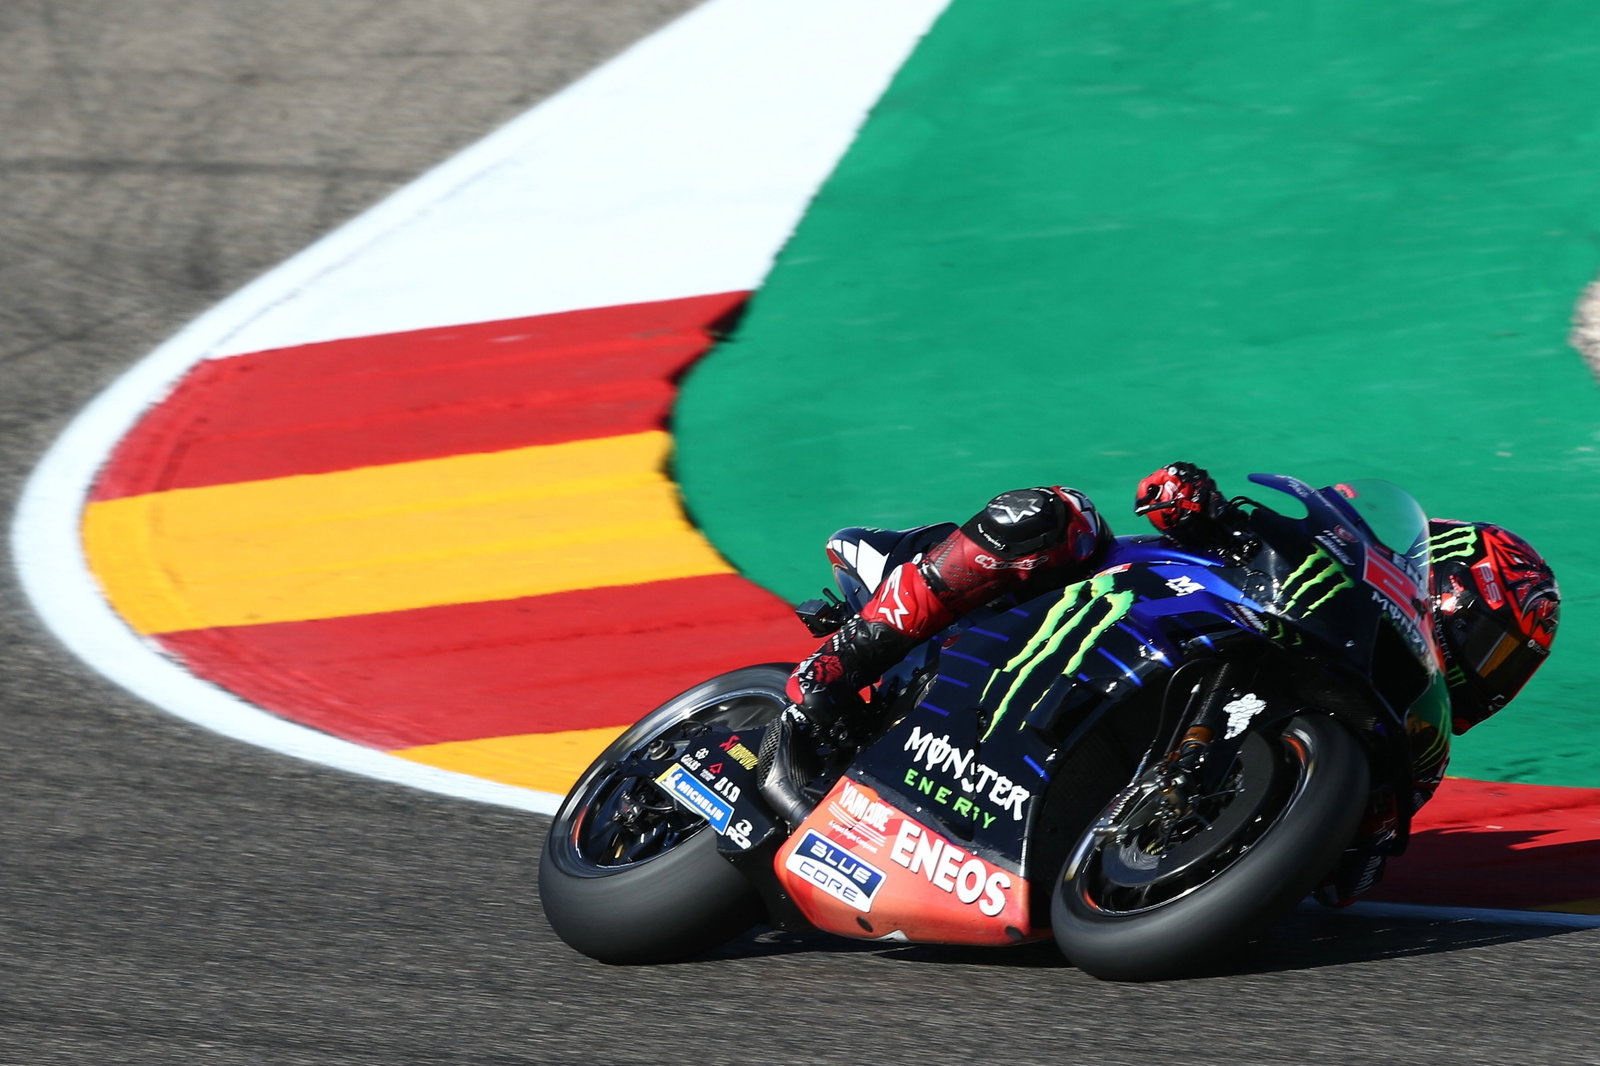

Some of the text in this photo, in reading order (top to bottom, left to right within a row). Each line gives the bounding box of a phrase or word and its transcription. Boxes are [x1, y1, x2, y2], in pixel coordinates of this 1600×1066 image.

[677, 781, 725, 820] MICHELIN
[800, 861, 858, 902] CORE
[810, 840, 872, 884] BLUE
[890, 820, 1012, 916] ENEOS
